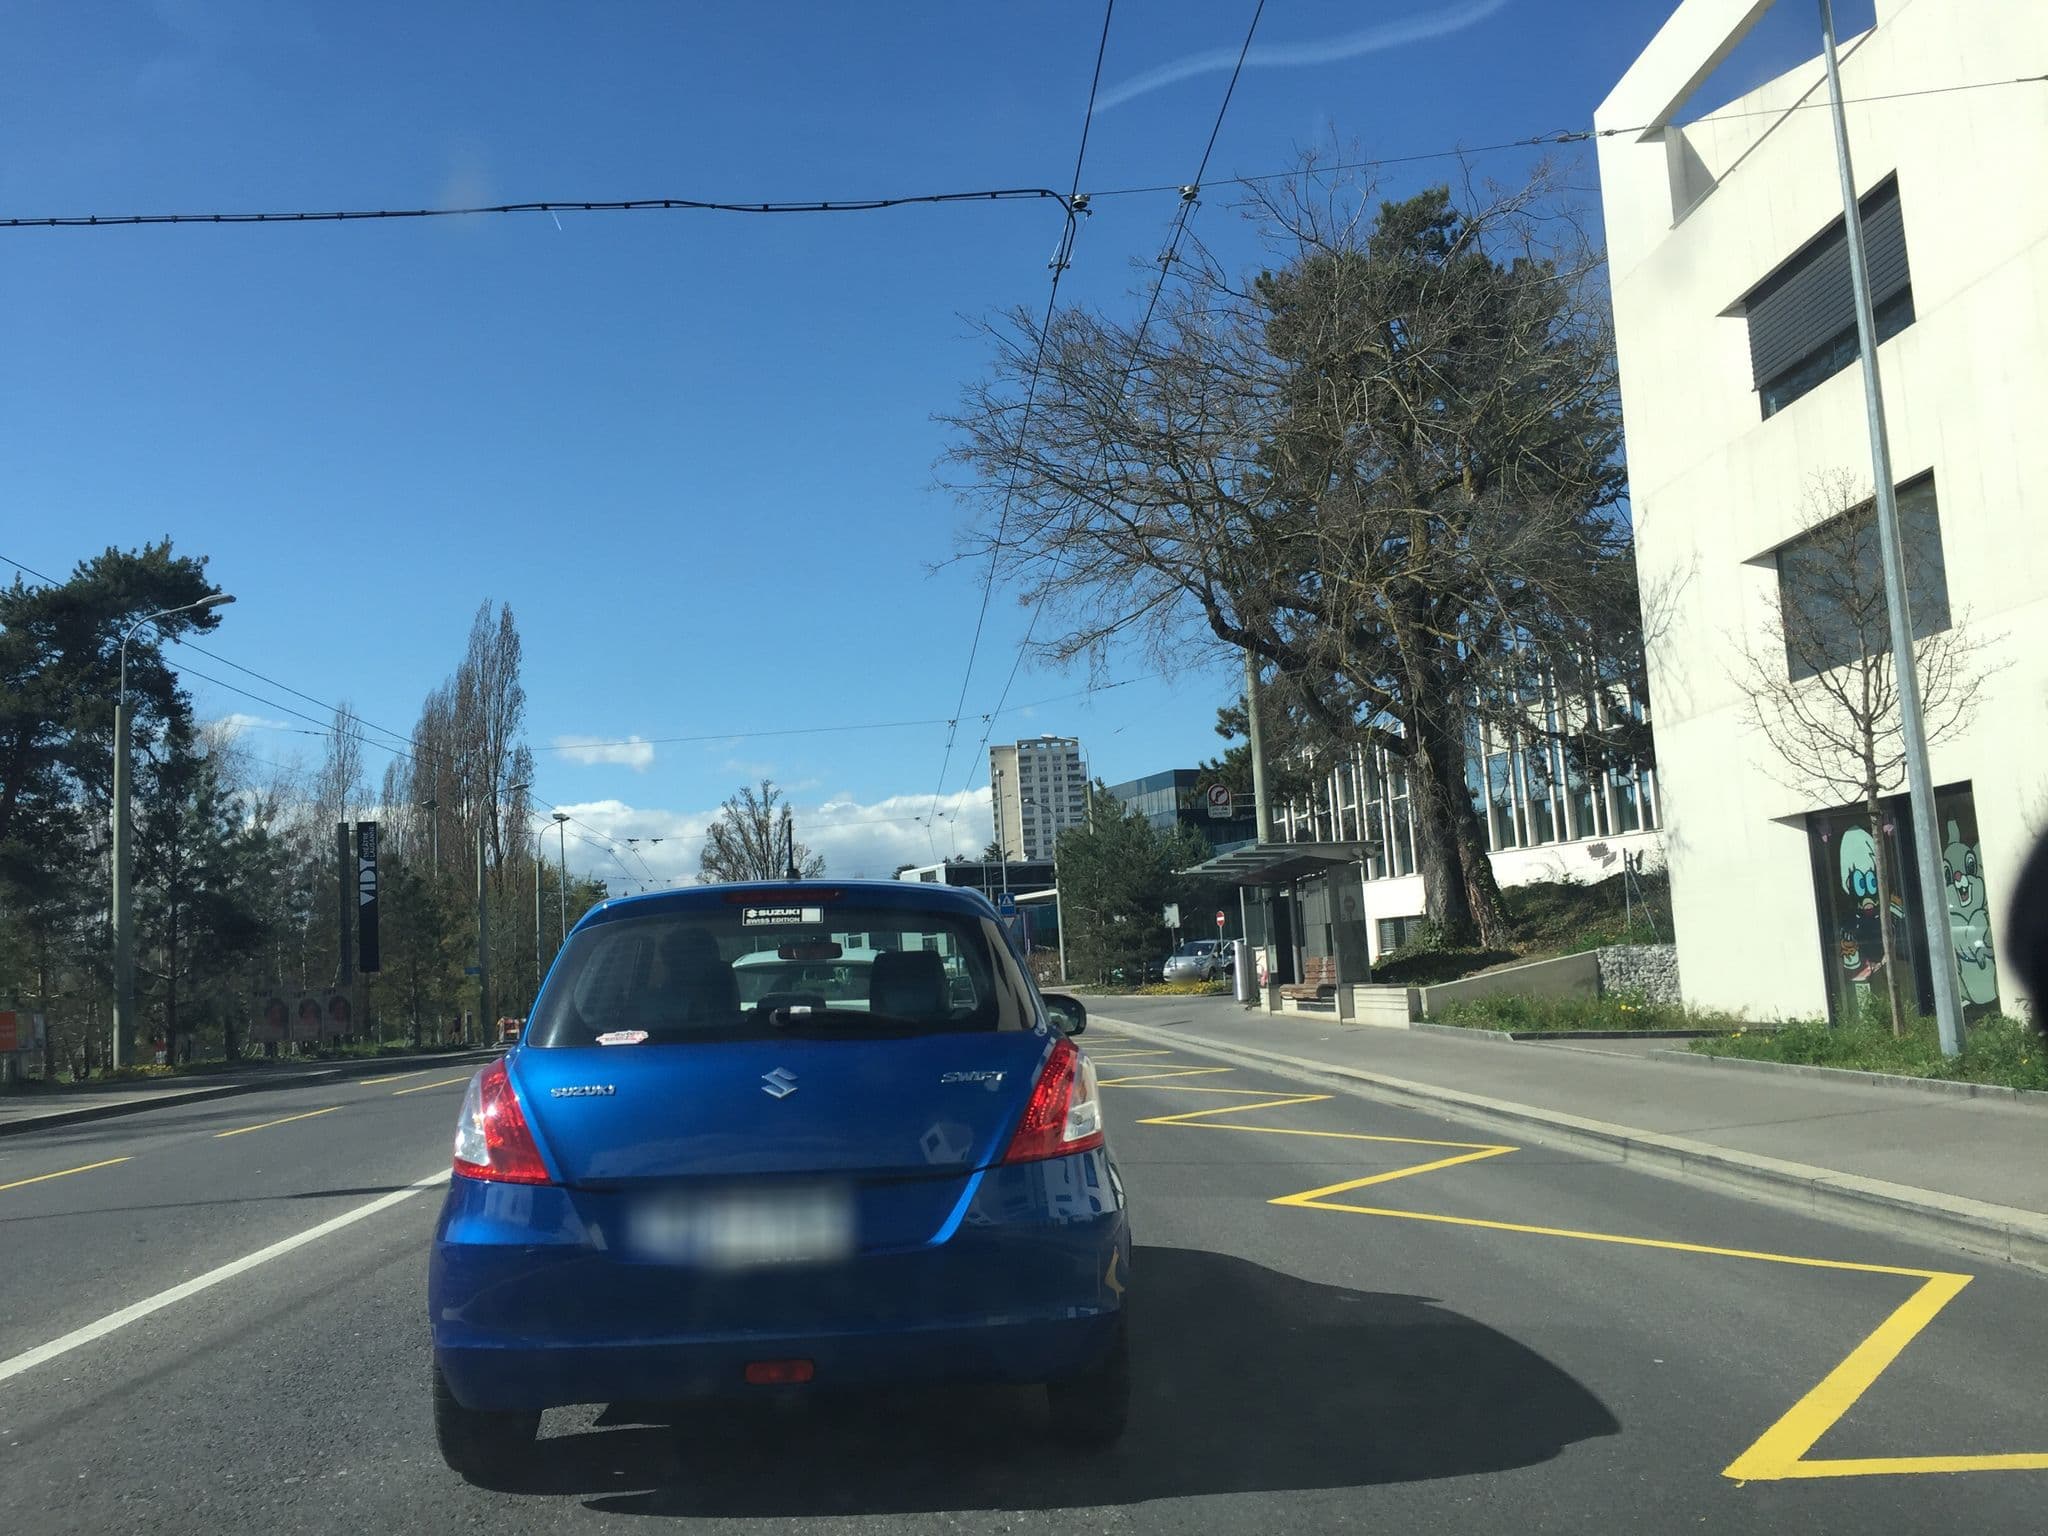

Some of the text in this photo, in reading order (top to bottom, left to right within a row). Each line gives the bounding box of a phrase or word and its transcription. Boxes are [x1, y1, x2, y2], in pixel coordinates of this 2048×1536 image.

[359, 856, 376, 907] VIDY
[758, 909, 801, 917] SUZUKI
[746, 918, 770, 926] SWISS
[941, 1071, 1008, 1083] SWIFT
[550, 1084, 615, 1098] SUZUKI
